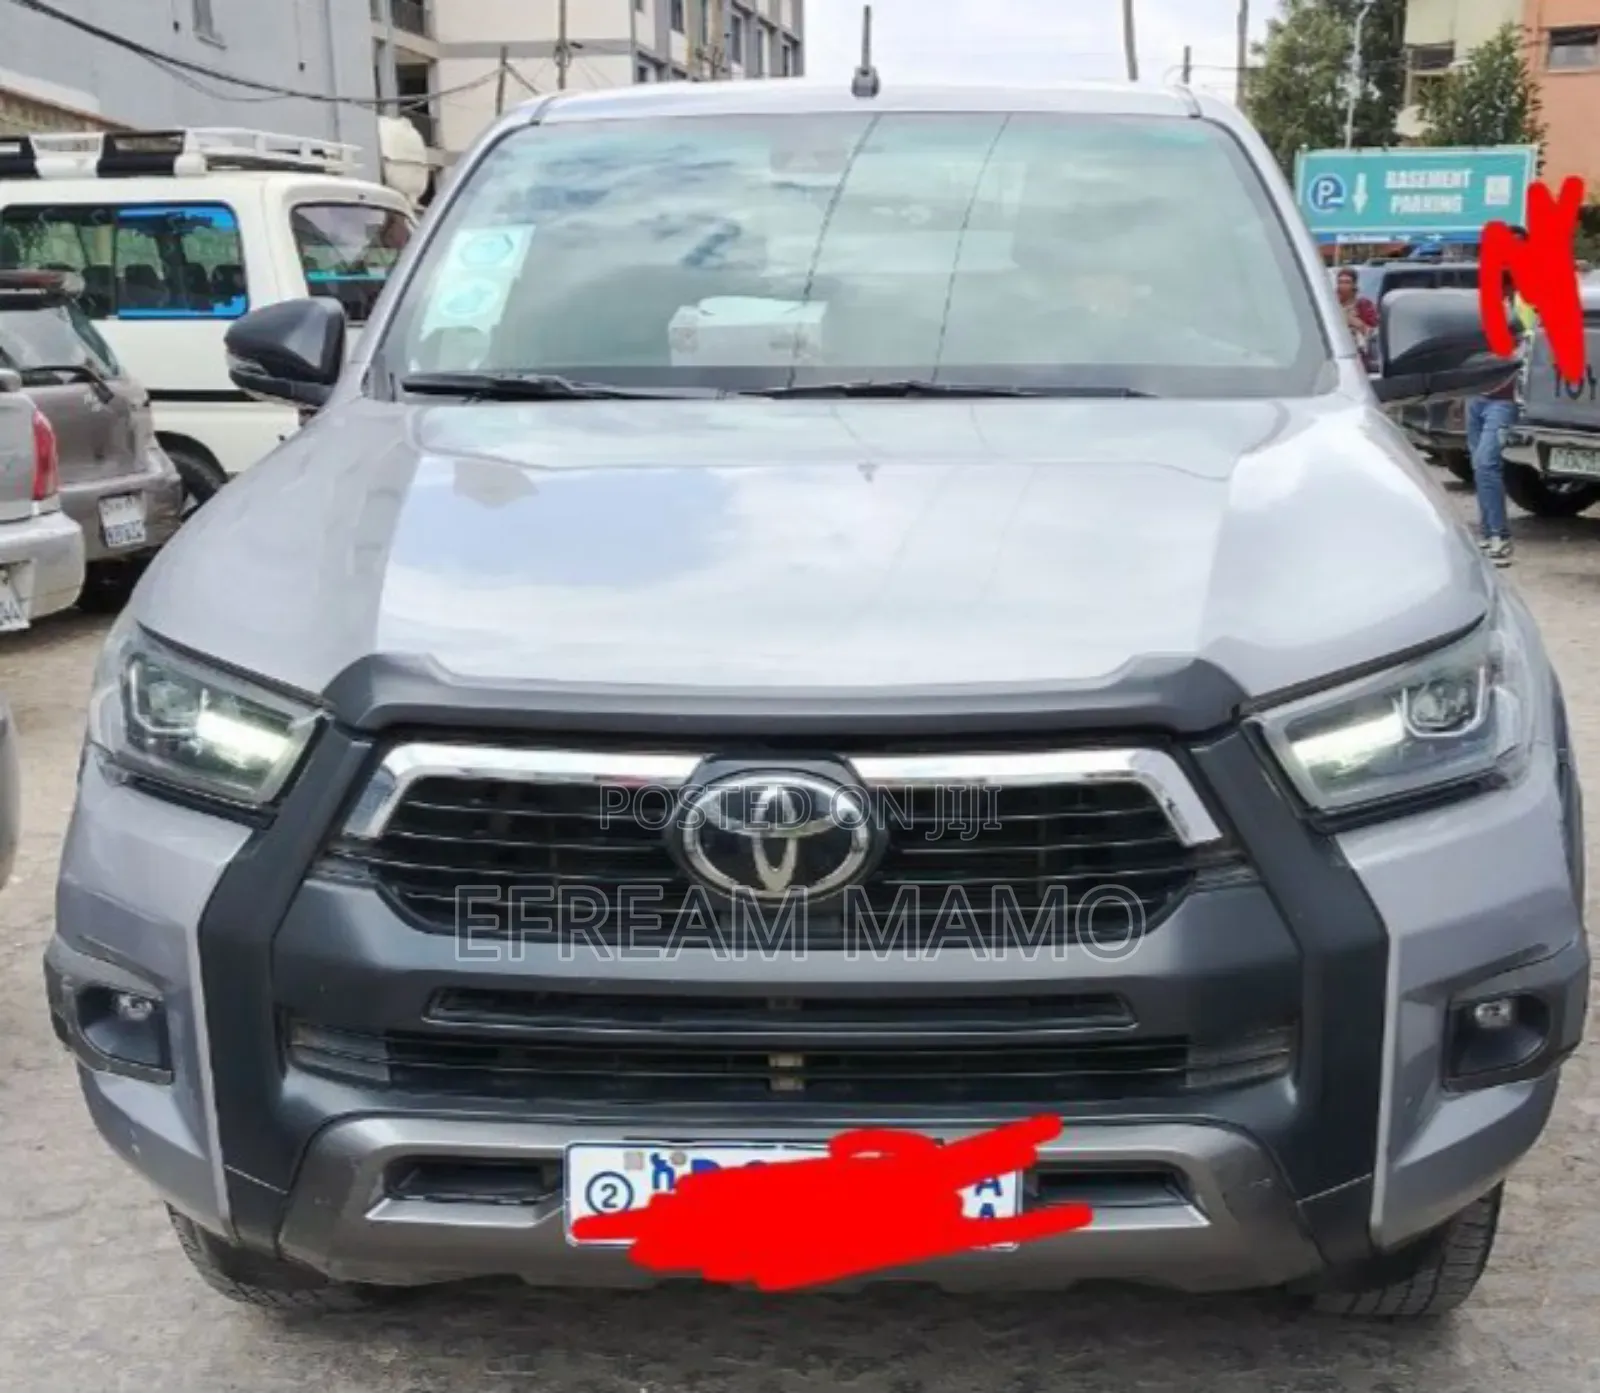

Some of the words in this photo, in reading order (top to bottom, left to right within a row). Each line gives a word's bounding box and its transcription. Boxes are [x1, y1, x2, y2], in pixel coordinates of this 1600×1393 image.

[1384, 169, 1472, 188] BASEMENT
[1390, 194, 1462, 213] PARKING
[600, 1183, 618, 1209] 2
